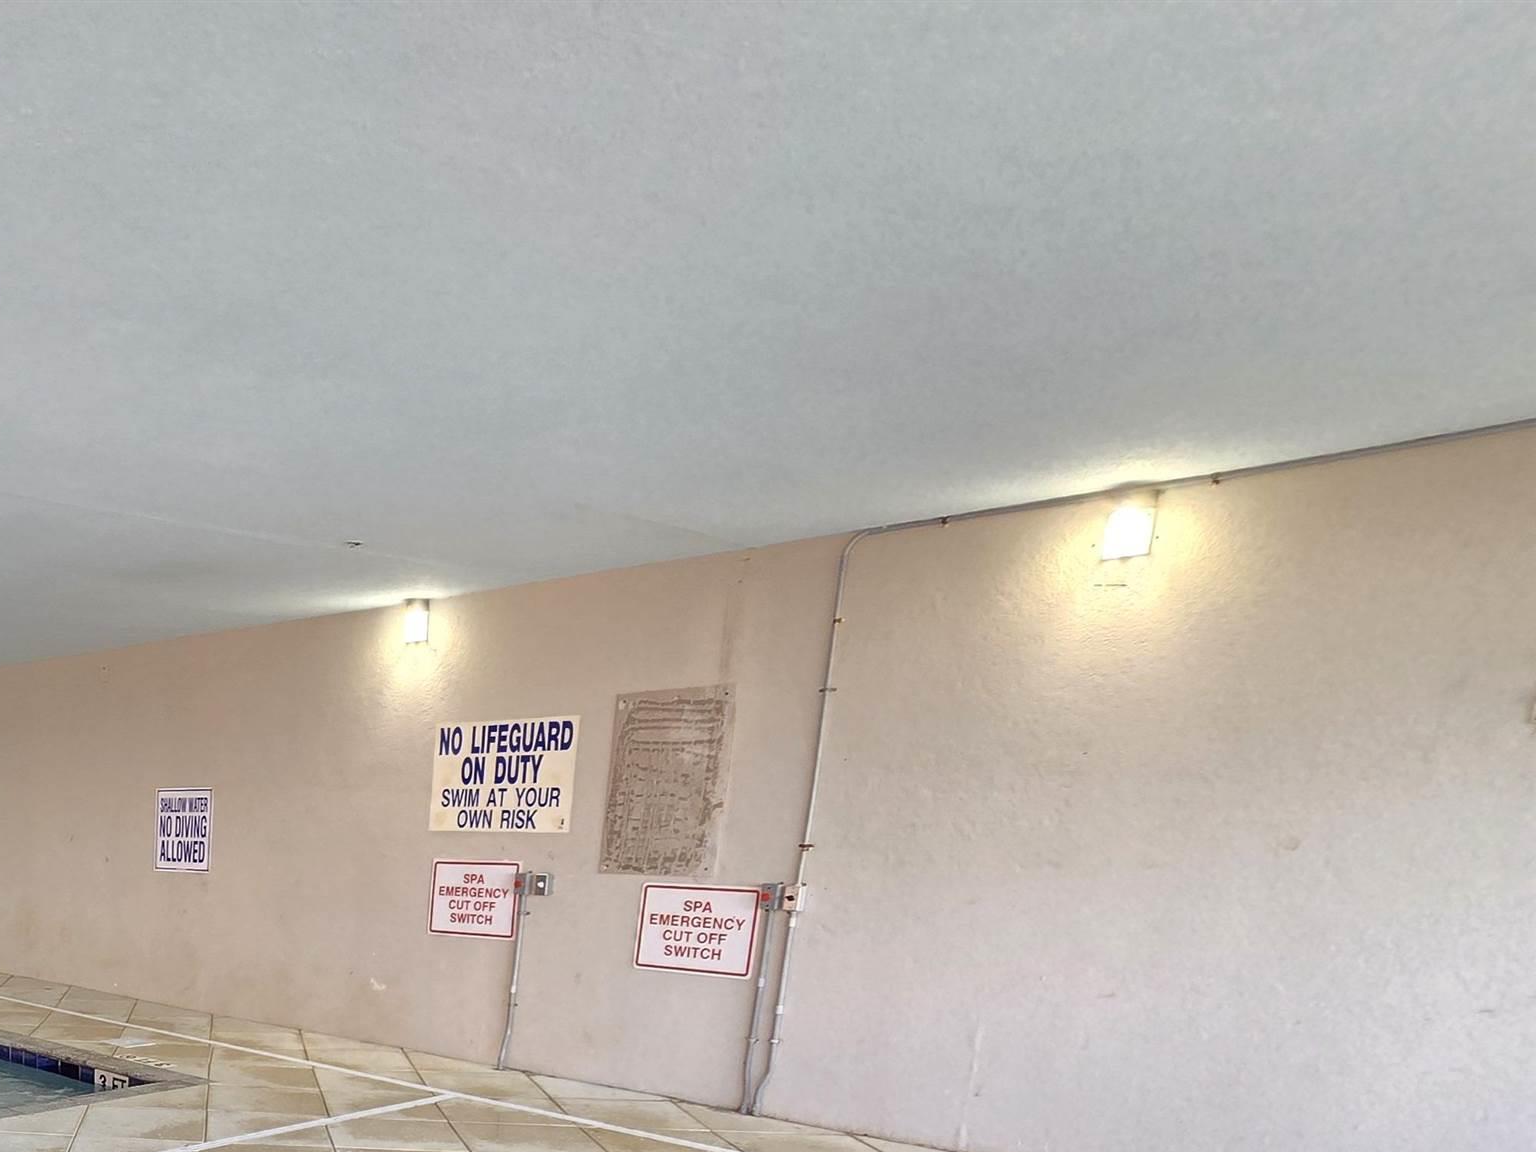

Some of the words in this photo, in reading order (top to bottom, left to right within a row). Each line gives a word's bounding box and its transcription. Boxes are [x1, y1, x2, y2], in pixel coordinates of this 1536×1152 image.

[439, 726, 463, 756] NO
[471, 720, 574, 754] LIFEGUARD
[461, 756, 486, 785] ON
[494, 754, 544, 784] DUTY
[160, 798, 186, 812] SHALLOW
[441, 788, 480, 807] SWIM
[486, 788, 508, 807] AT
[516, 788, 560, 807] YOUR
[457, 810, 493, 829] OWN
[500, 809, 538, 829] RISK
[160, 816, 172, 838] NO
[175, 816, 207, 838] DIVING
[160, 840, 206, 863] ALLOWED
[463, 874, 484, 884] SPA
[438, 886, 510, 898] EMERGENCY
[448, 900, 471, 910] CUT
[474, 901, 496, 912] OFF
[683, 900, 712, 913] SPA
[450, 912, 492, 925] SWITCH
[649, 913, 746, 931] EMERGENCY
[662, 930, 692, 942] CUT
[696, 932, 728, 945] OFF
[664, 945, 722, 960] SWITCH
